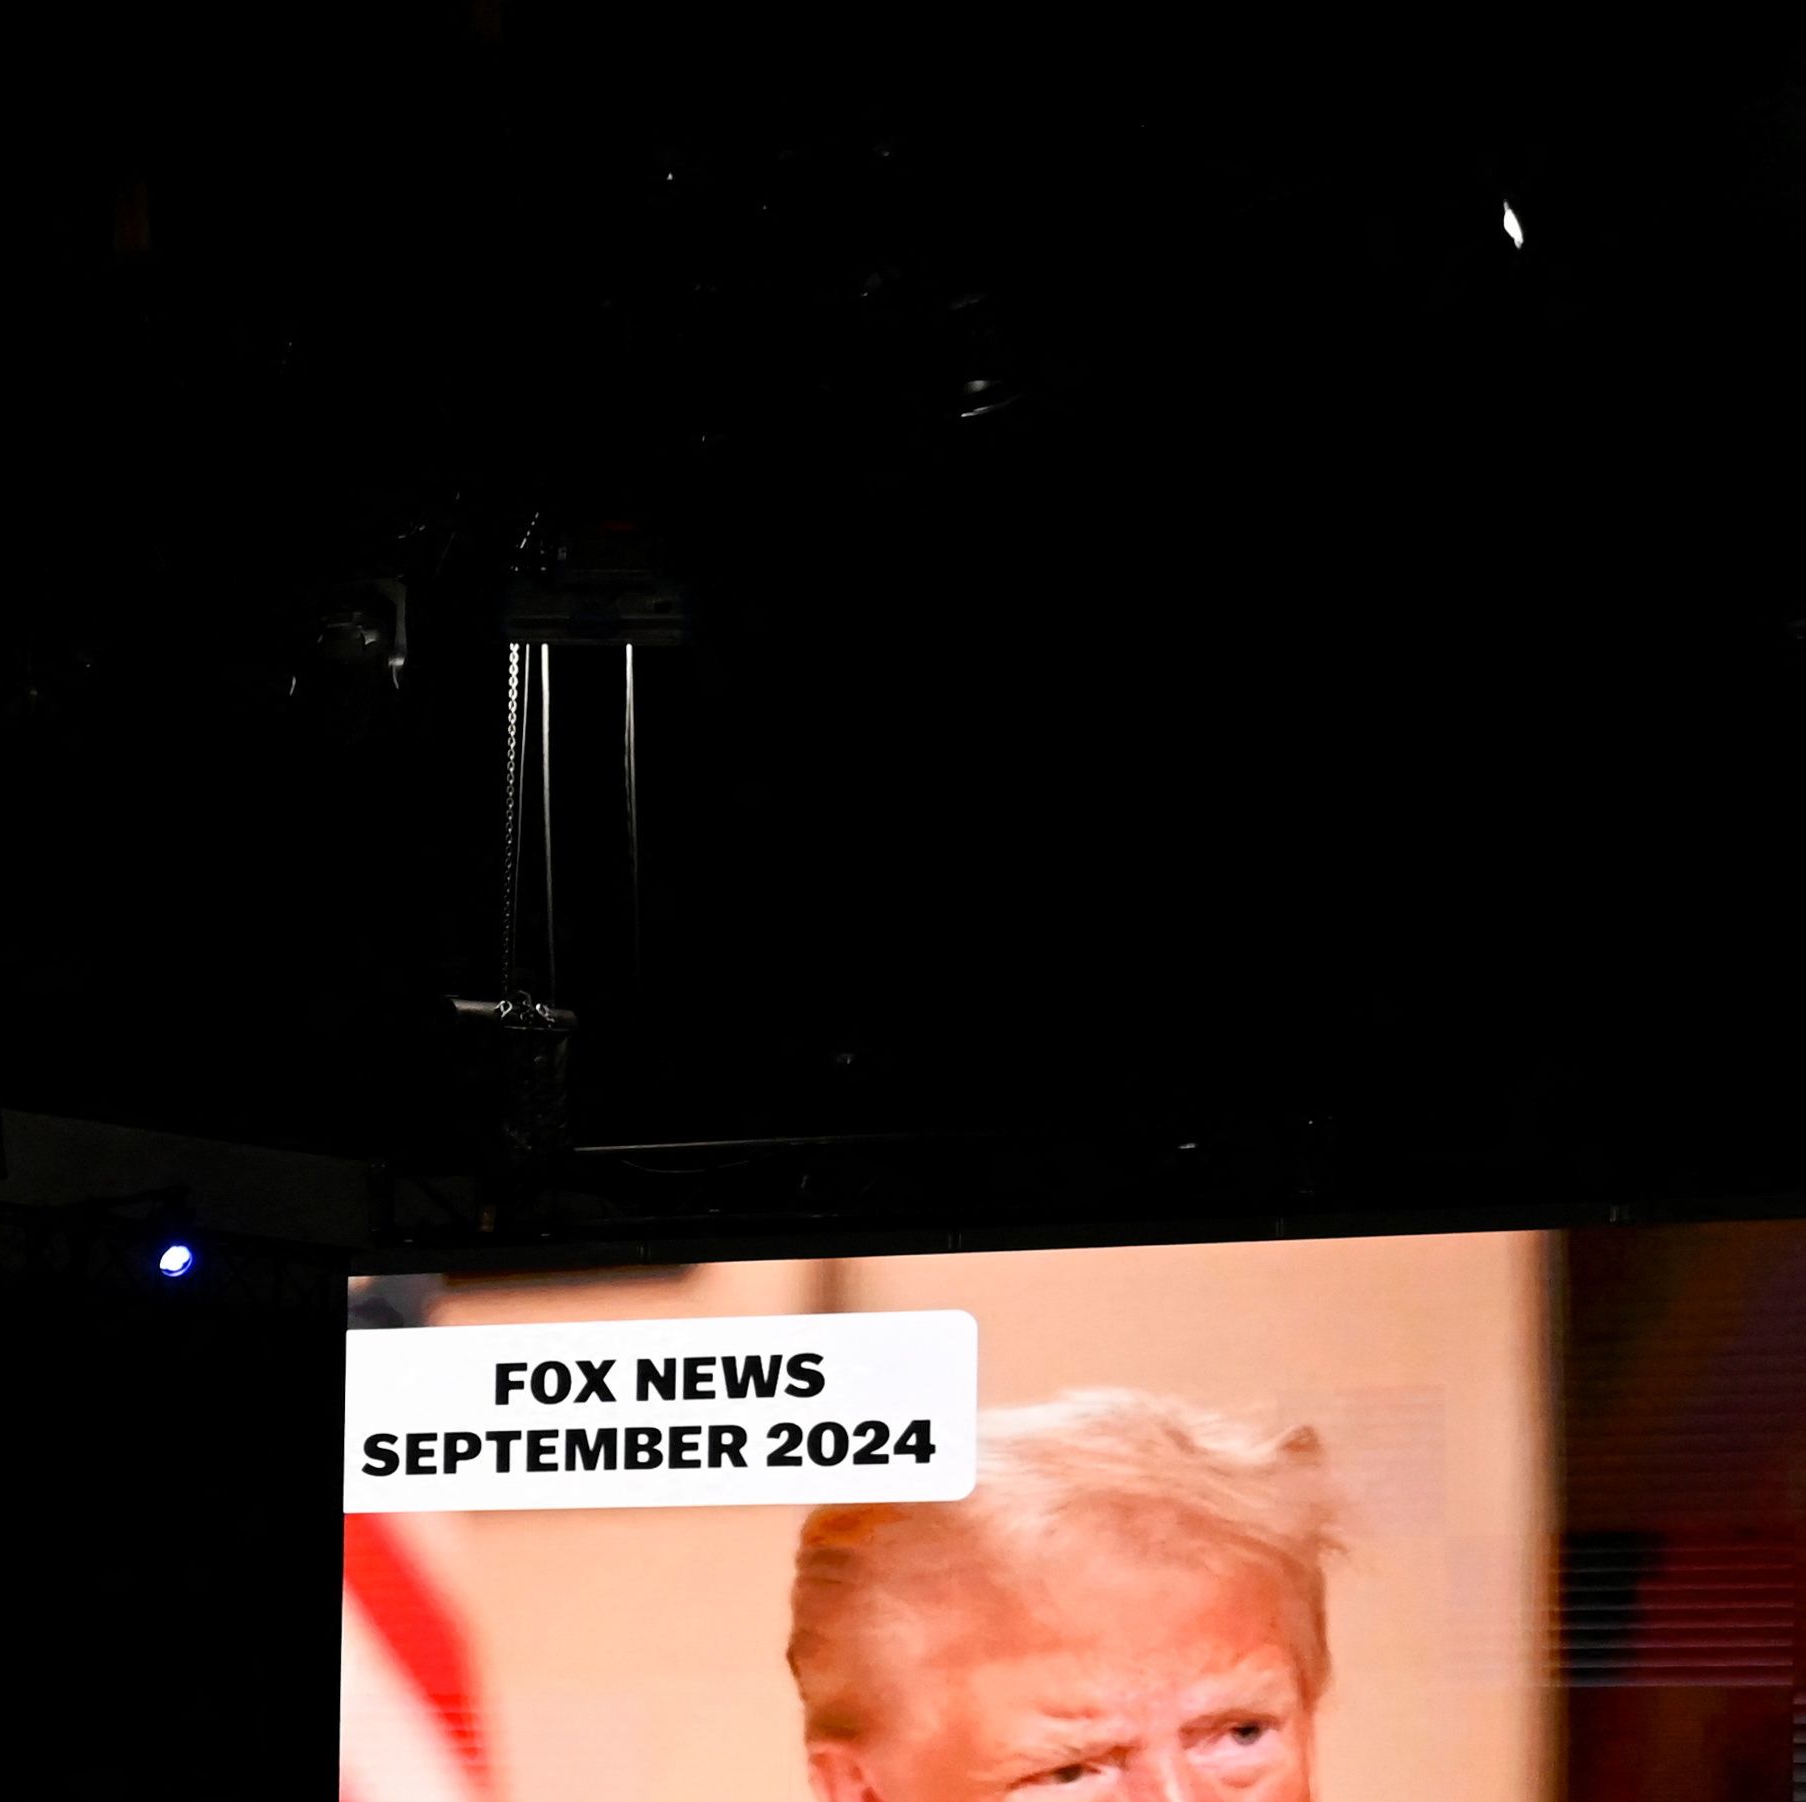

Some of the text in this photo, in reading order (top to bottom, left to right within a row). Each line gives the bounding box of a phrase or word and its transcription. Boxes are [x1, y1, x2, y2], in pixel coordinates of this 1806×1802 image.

[494, 1352, 826, 1406] FOX NEWS
[361, 1418, 937, 1477] SEPTEMBER 2024
